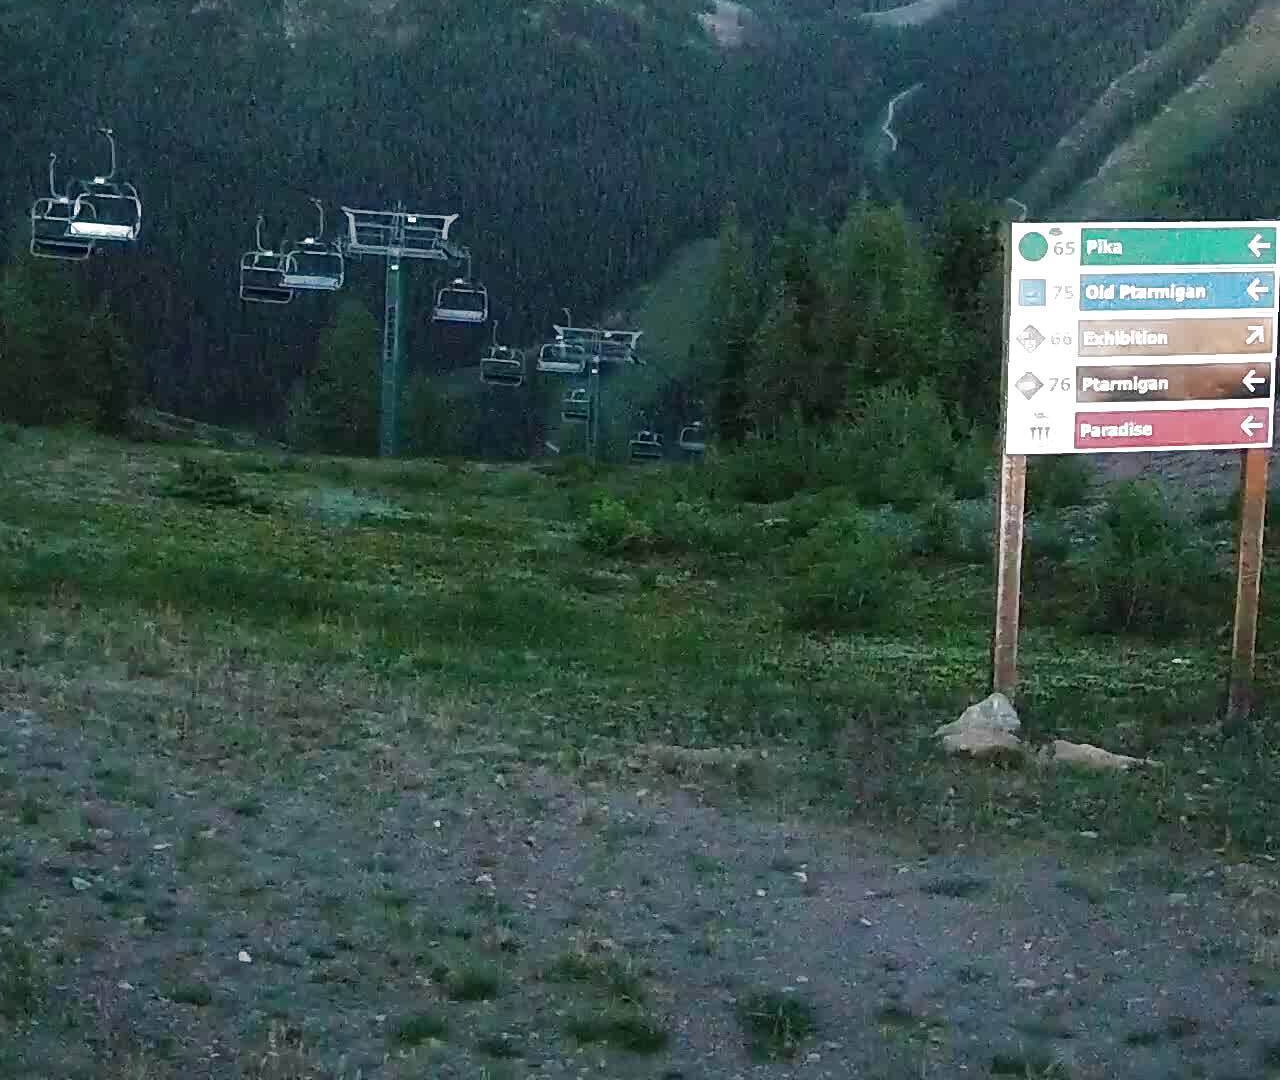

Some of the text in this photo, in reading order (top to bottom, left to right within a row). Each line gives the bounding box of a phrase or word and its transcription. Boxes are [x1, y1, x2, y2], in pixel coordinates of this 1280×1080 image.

[1053, 238, 1123, 256] 65 Pika
[1053, 283, 1207, 303] 75 Old Ptarmigan
[1083, 330, 1168, 346] Exhibition
[1048, 376, 1169, 395] 76 Ptarmigan
[1080, 421, 1153, 439] Paradise
